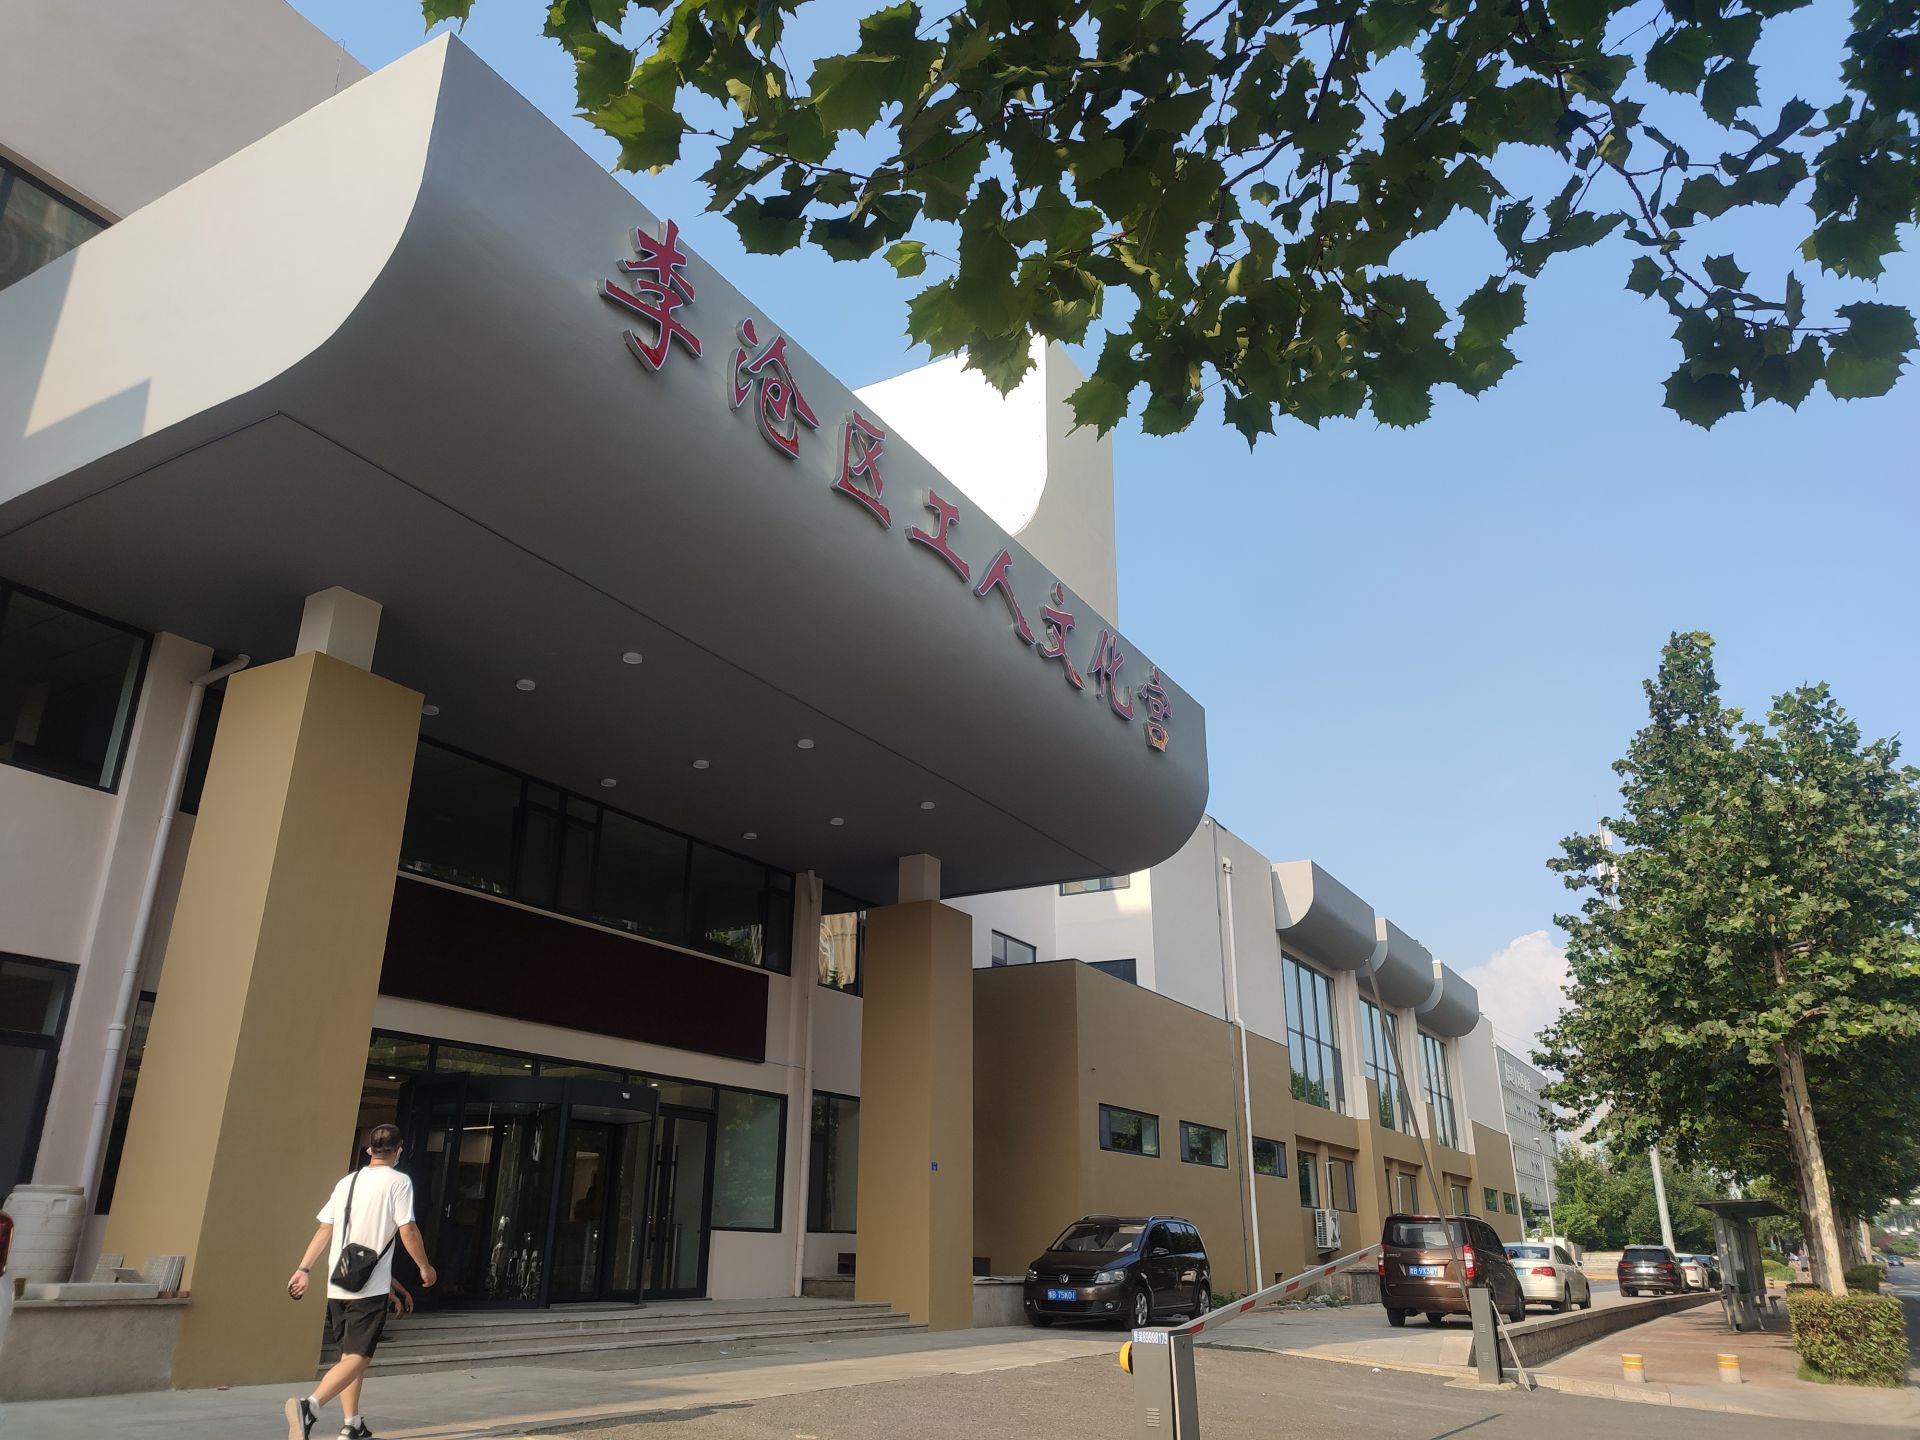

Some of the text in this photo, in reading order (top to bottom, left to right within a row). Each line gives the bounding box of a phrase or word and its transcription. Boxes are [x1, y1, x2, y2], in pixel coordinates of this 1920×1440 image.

[598, 218, 1172, 752] 李沧区工人文化宫
